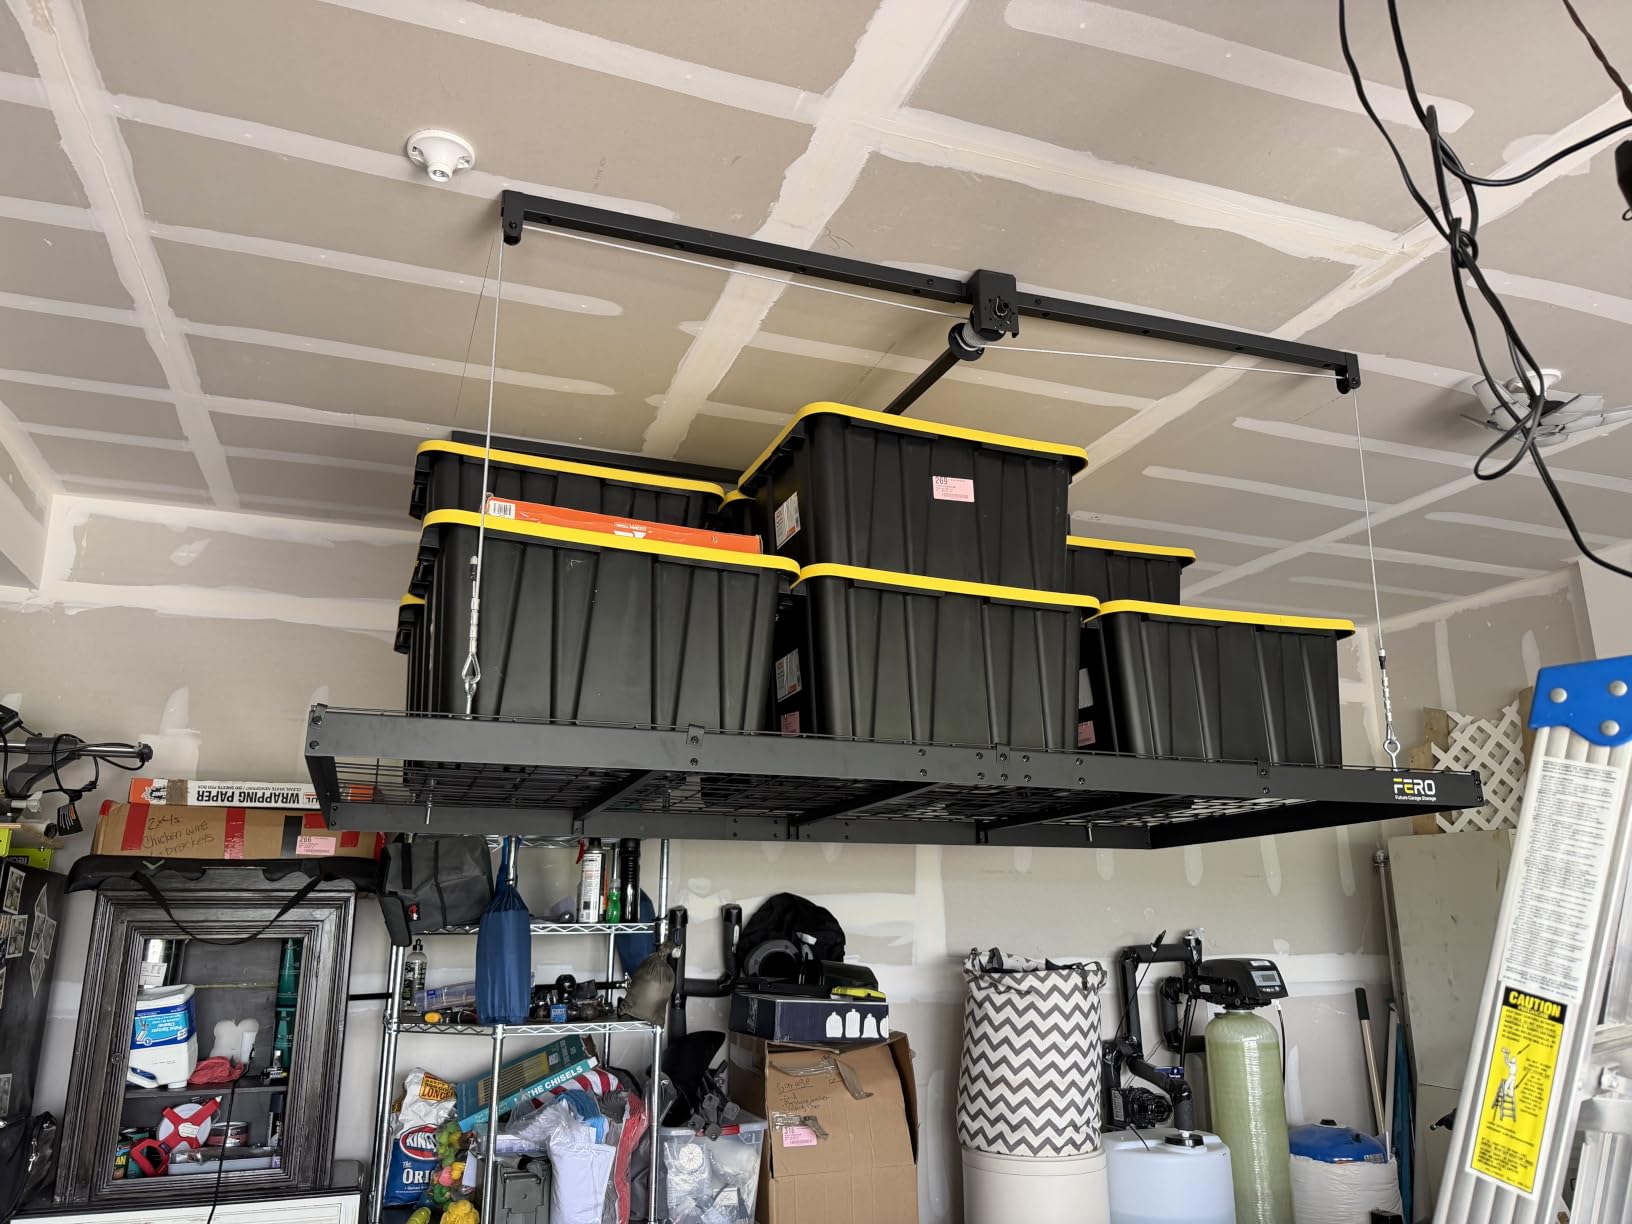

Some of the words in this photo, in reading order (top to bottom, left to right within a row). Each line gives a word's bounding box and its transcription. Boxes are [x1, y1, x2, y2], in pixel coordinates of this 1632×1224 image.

[1393, 778, 1436, 795] FERO
[196, 790, 235, 803] PAPER
[238, 791, 300, 804] WRAPPING
[1508, 991, 1561, 1018] CAUTION
[545, 1066, 583, 1090] CHISELS
